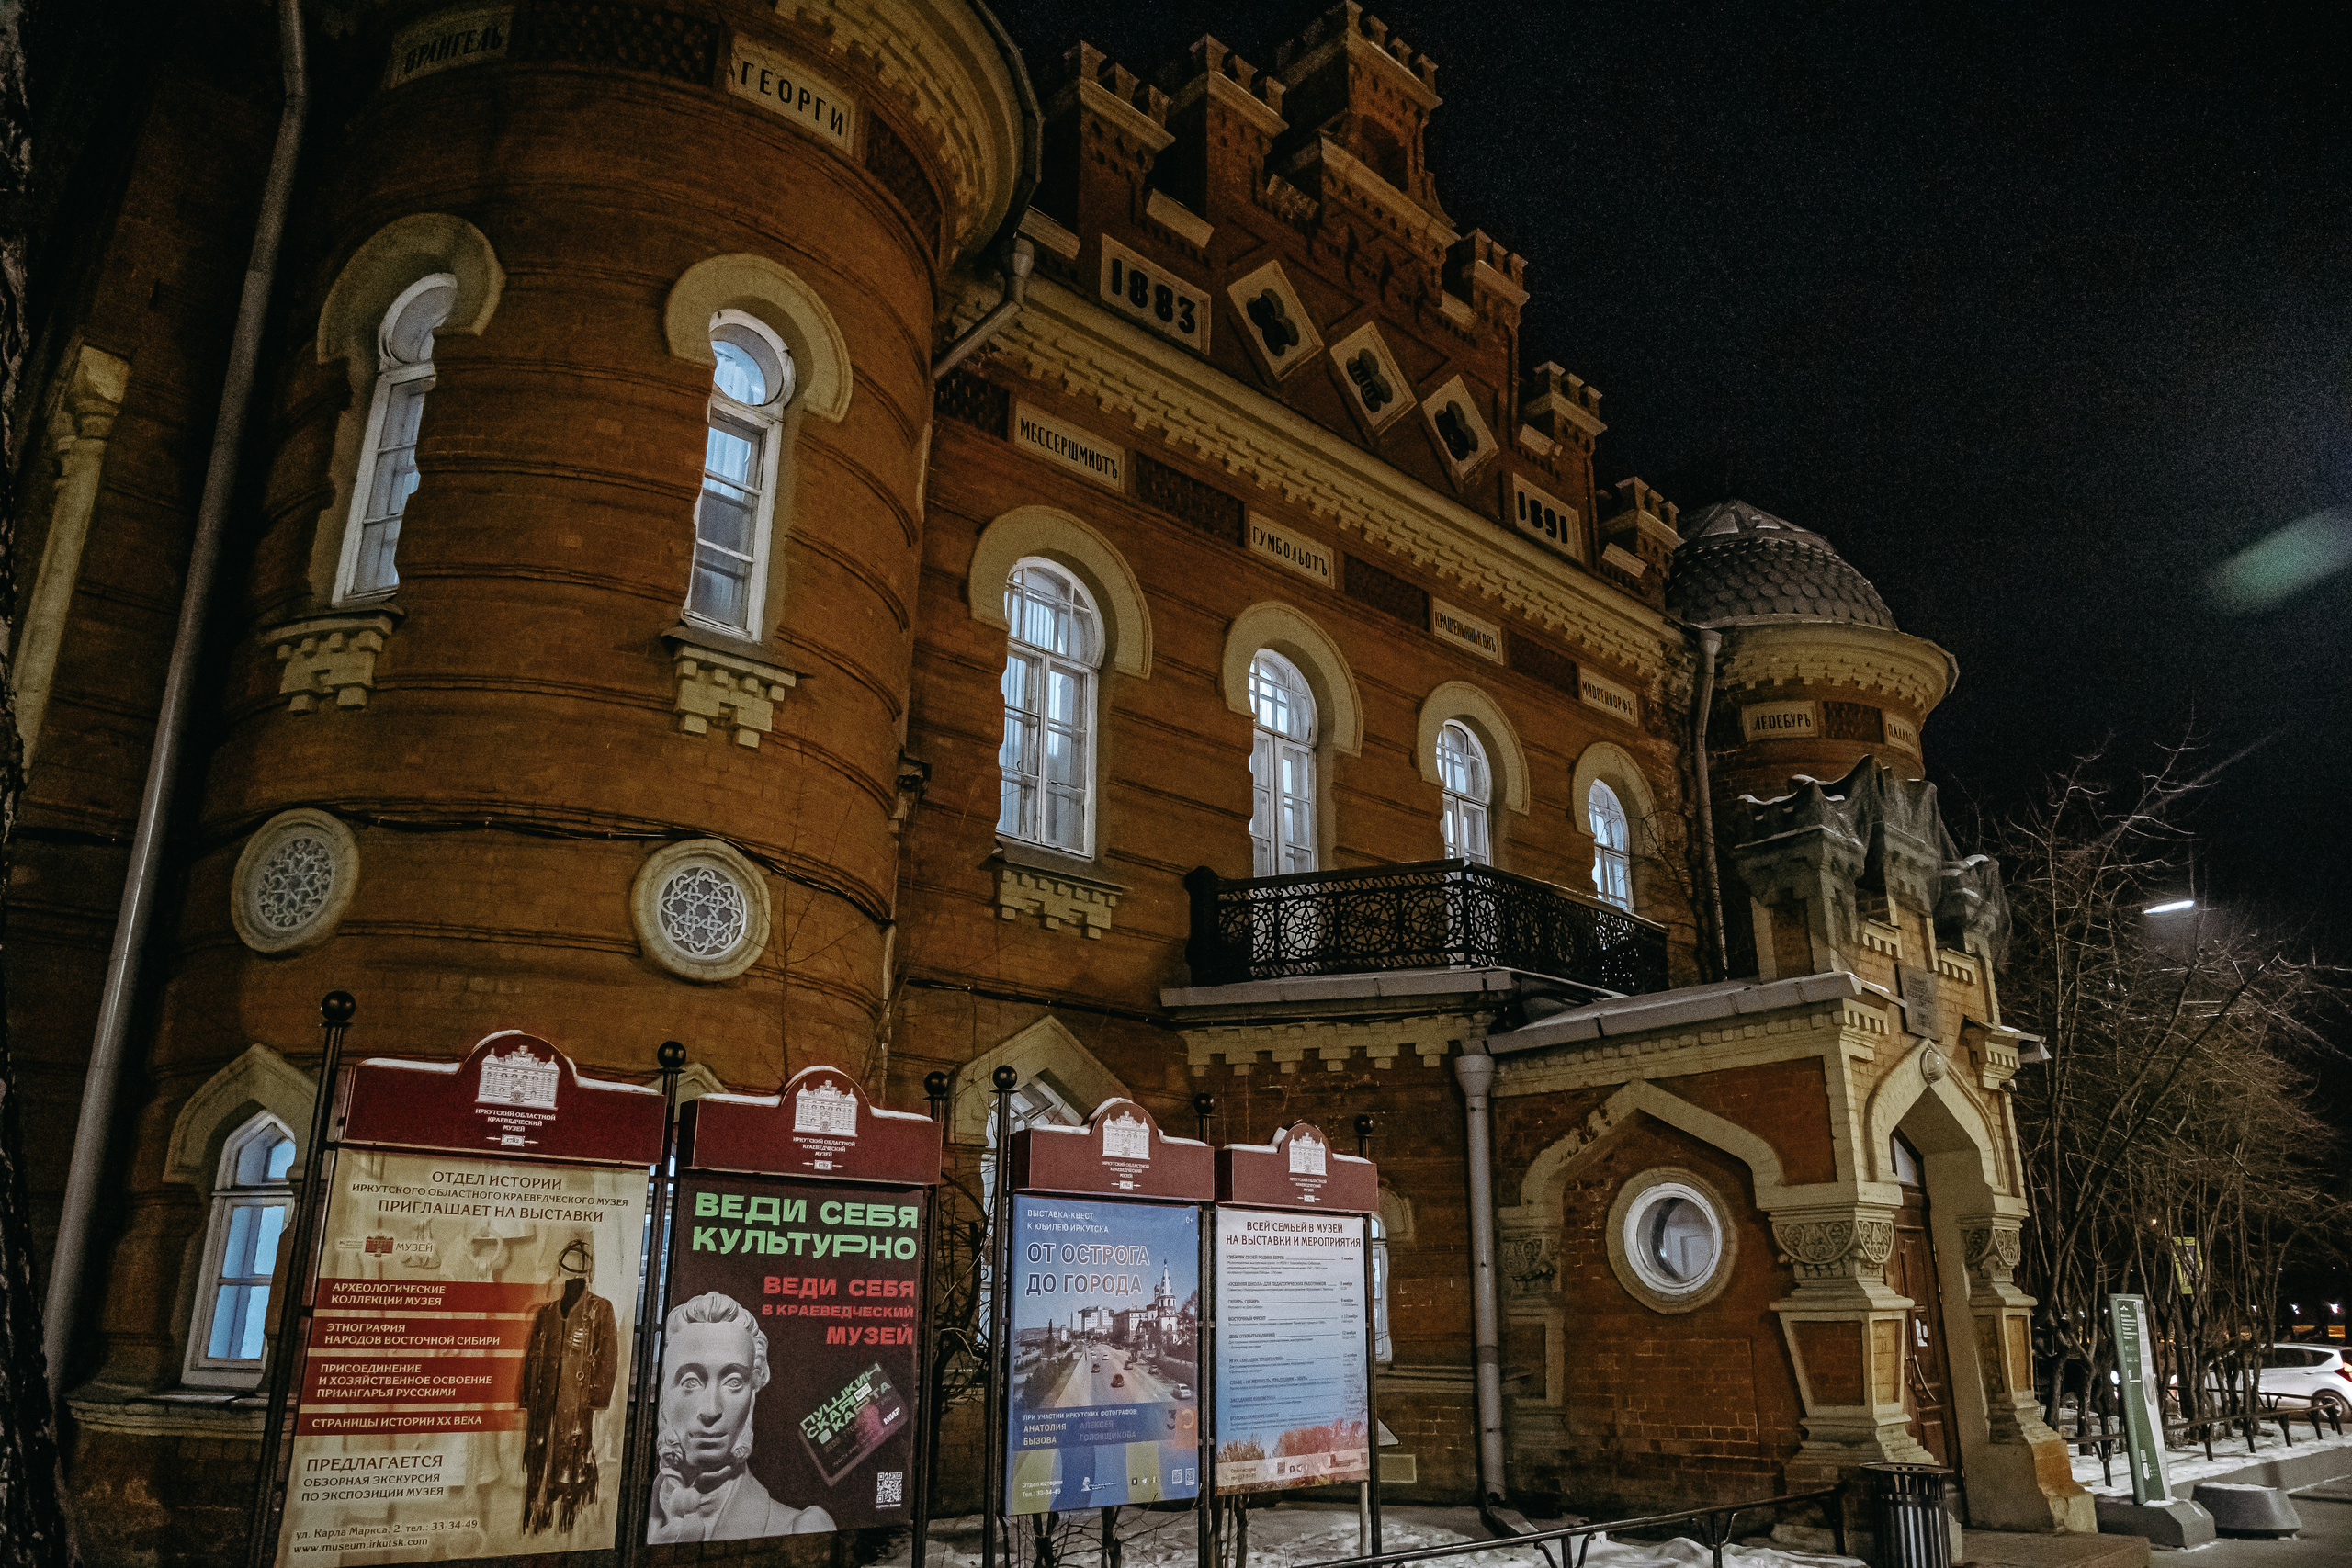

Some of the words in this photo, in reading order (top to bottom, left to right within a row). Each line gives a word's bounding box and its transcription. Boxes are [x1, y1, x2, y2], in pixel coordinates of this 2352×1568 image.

[741, 61, 843, 136] ГЕОРГИ
[1112, 258, 1196, 334] 1883
[1517, 491, 1568, 545] 1891
[475, 1108, 514, 1117] ИРКУТСКИЙ
[514, 1111, 556, 1121] ОБЛАСТНОЙ
[487, 1116, 543, 1127] КРАЕВЕДЧЕСКИЙ
[432, 1170, 485, 1188] ОТДЕЛ
[489, 1173, 562, 1190] ИСТОРИИ
[352, 1183, 426, 1196] ИРКУТСКОГО
[428, 1188, 502, 1200] ОБЛАСТНОГО
[503, 1192, 595, 1206] КРАЕВЕДЧЕСКОГО
[596, 1198, 628, 1207] МУЗЕЯ
[378, 1199, 492, 1217] ПРИГЛАШАЕТ
[494, 1205, 515, 1218] НА
[519, 1207, 604, 1223] ВЫСТАВКИ
[695, 1191, 808, 1226] ВЕДИ
[820, 1201, 919, 1229] СЕБЯ
[1027, 1209, 1094, 1220] ВЫСТАВКА-КВЕСТ
[1026, 1222, 1033, 1230] К
[1034, 1223, 1069, 1232] ЮБИЛЕЮ
[1070, 1224, 1109, 1234] ИРКУТСКА
[1247, 1220, 1271, 1232] ВСЕЙ
[1272, 1221, 1306, 1233] СЕМЬЕЙ
[1308, 1223, 1315, 1232] В
[1316, 1222, 1343, 1234] МУЗЕЙ
[395, 1242, 434, 1253] МУЗЕЙ
[692, 1226, 917, 1260] КУЛЬТУРНО
[1226, 1235, 1239, 1245] НА
[1241, 1235, 1291, 1246] ВЫСТАВКИ
[1293, 1236, 1299, 1246] И
[1301, 1237, 1361, 1247] МЕРОПРИЯТИЯ
[1026, 1242, 1057, 1264] ОТ
[1061, 1243, 1150, 1266] ОСТРОГА
[332, 1282, 446, 1294] АРХЕОЛОГИЧЕСКИЕ
[763, 1276, 837, 1299] ВЕДИ
[848, 1279, 915, 1298] СЕБЯ
[1024, 1272, 1057, 1297] ДО
[1063, 1273, 1143, 1297] ГОРОДА
[331, 1294, 403, 1306] КОЛЛЕКЦИИ
[404, 1296, 442, 1306] МУЗЕЯ
[762, 1304, 772, 1315] В
[775, 1304, 914, 1319] КРАЕВЕДЧЕСКИЙ
[326, 1323, 406, 1333] ЭТНОГРАФИЯ
[826, 1324, 913, 1346] МУЗЕЙ
[324, 1335, 382, 1346] НАРОДОВ
[384, 1334, 455, 1346] ВОСТОЧНОЙ
[457, 1336, 501, 1346] СИБИРИ
[320, 1363, 422, 1374] ПРИСОЕДИНЕНИЕ
[318, 1376, 327, 1385] И
[329, 1374, 431, 1385] ХОЗЯЙСТВЕННОЕ
[432, 1375, 492, 1385] ОСВОЕНИЕ
[316, 1388, 394, 1398] ПРИАНГАРЬЯ
[396, 1387, 457, 1397] РУССКИМИ
[311, 1417, 379, 1428] СТРАНИЦЫ
[380, 1416, 435, 1427] ИСТОРИИ
[453, 1416, 482, 1425] ВЕКА
[883, 1406, 900, 1425] МИР
[1037, 1413, 1065, 1421] УЧАСТИИ
[1065, 1411, 1099, 1419] ИРКУТСКИХ
[1023, 1423, 1067, 1433] АНАТОЛИЯ
[1080, 1419, 1114, 1429] АЛЕКСЕЯ
[1023, 1436, 1057, 1446] БЫЗОВА
[306, 1455, 443, 1472] ПРЕДЛАГАЕТСЯ
[303, 1475, 369, 1488] ОБЗОРНАЯ
[372, 1473, 440, 1484] ЭКСКУРСИЯ
[301, 1492, 320, 1502] ПО
[322, 1488, 404, 1501] ЭКСПОЗИЦИИ
[405, 1486, 444, 1497] МУЗЕЯ
[295, 1531, 311, 1540] ул.
[313, 1528, 346, 1539] Карла
[348, 1526, 390, 1538] Маркса,
[393, 1524, 403, 1535] 2,
[405, 1523, 429, 1533] тел.:
[431, 1519, 478, 1532] 33-34-49
[293, 1537, 428, 1553] www.museum.irkutsk.com
